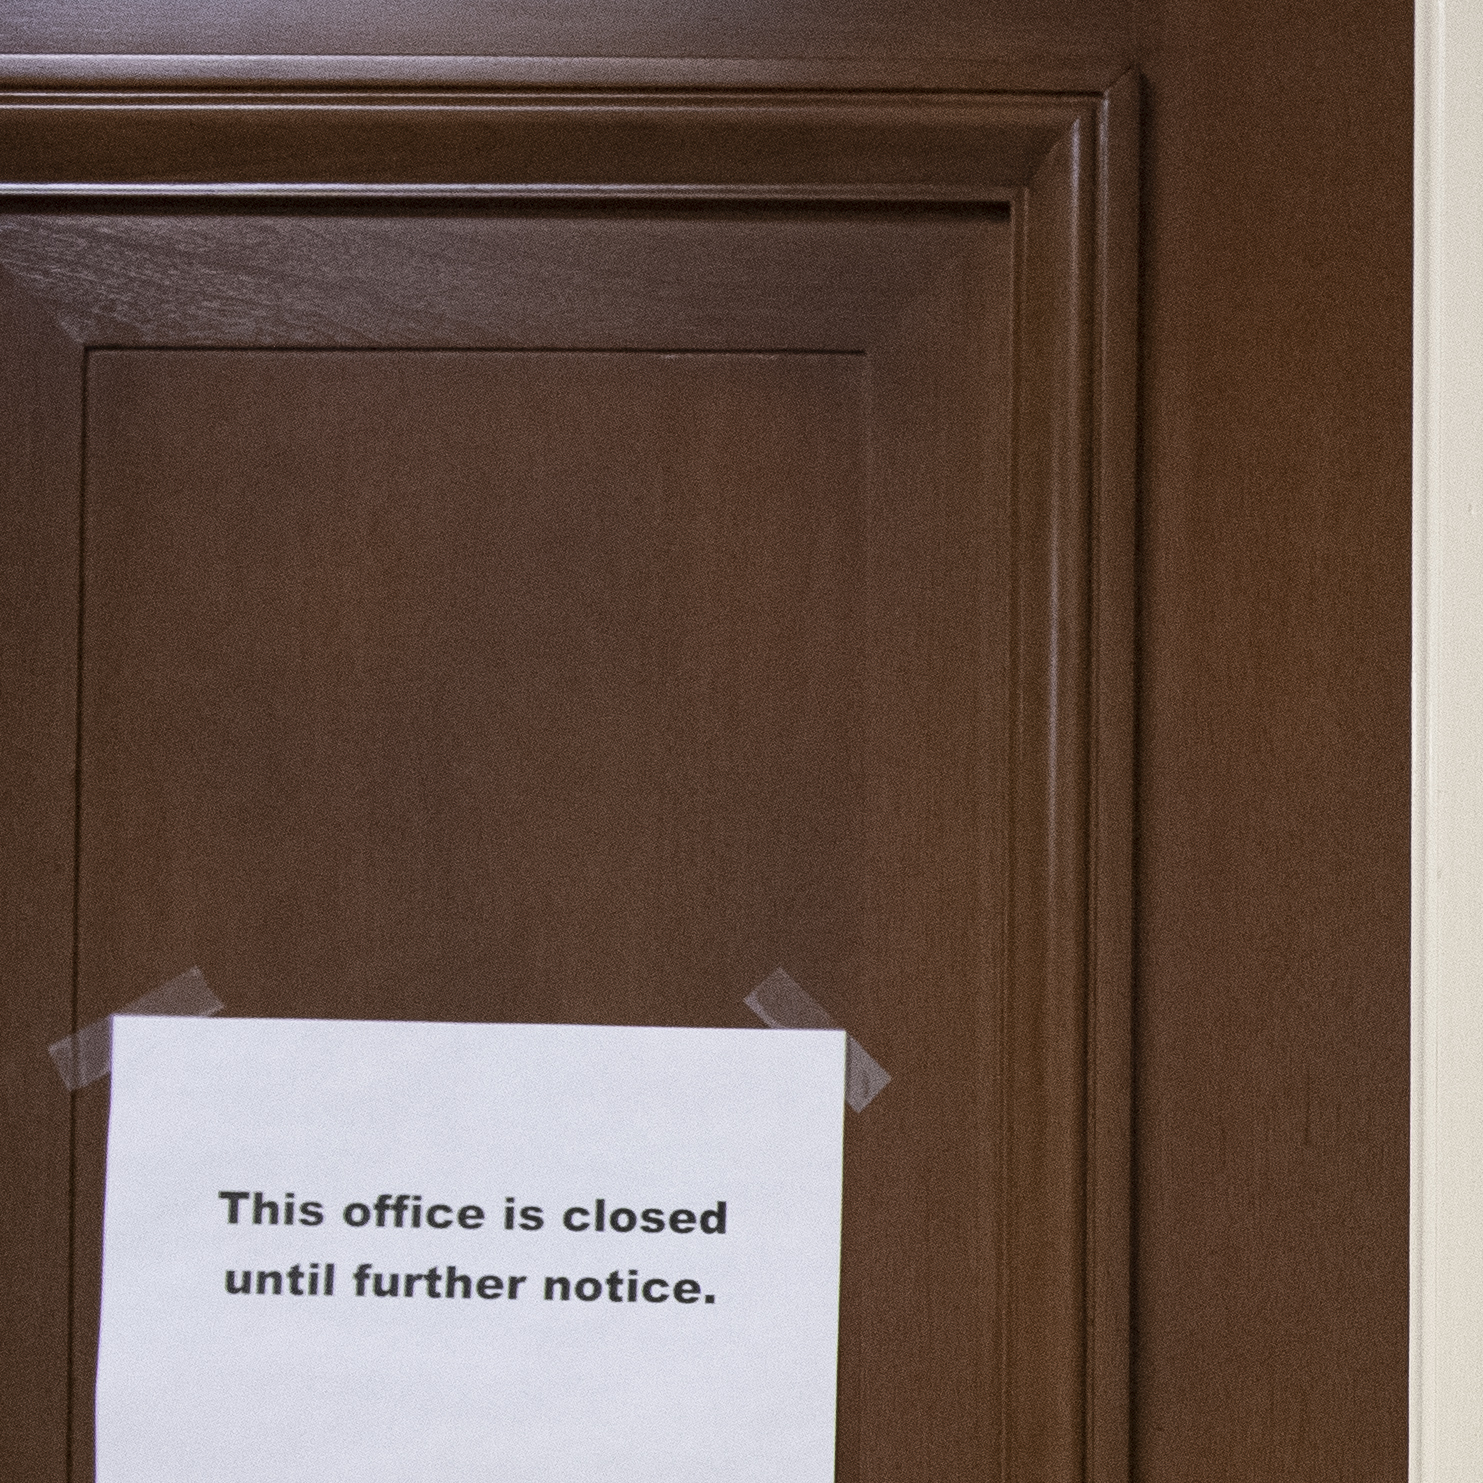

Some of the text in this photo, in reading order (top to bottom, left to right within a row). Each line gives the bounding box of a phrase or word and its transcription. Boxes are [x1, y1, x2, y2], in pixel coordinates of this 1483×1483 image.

[219, 1191, 727, 1235] This office is closed
[226, 1262, 716, 1305] until further notice.
